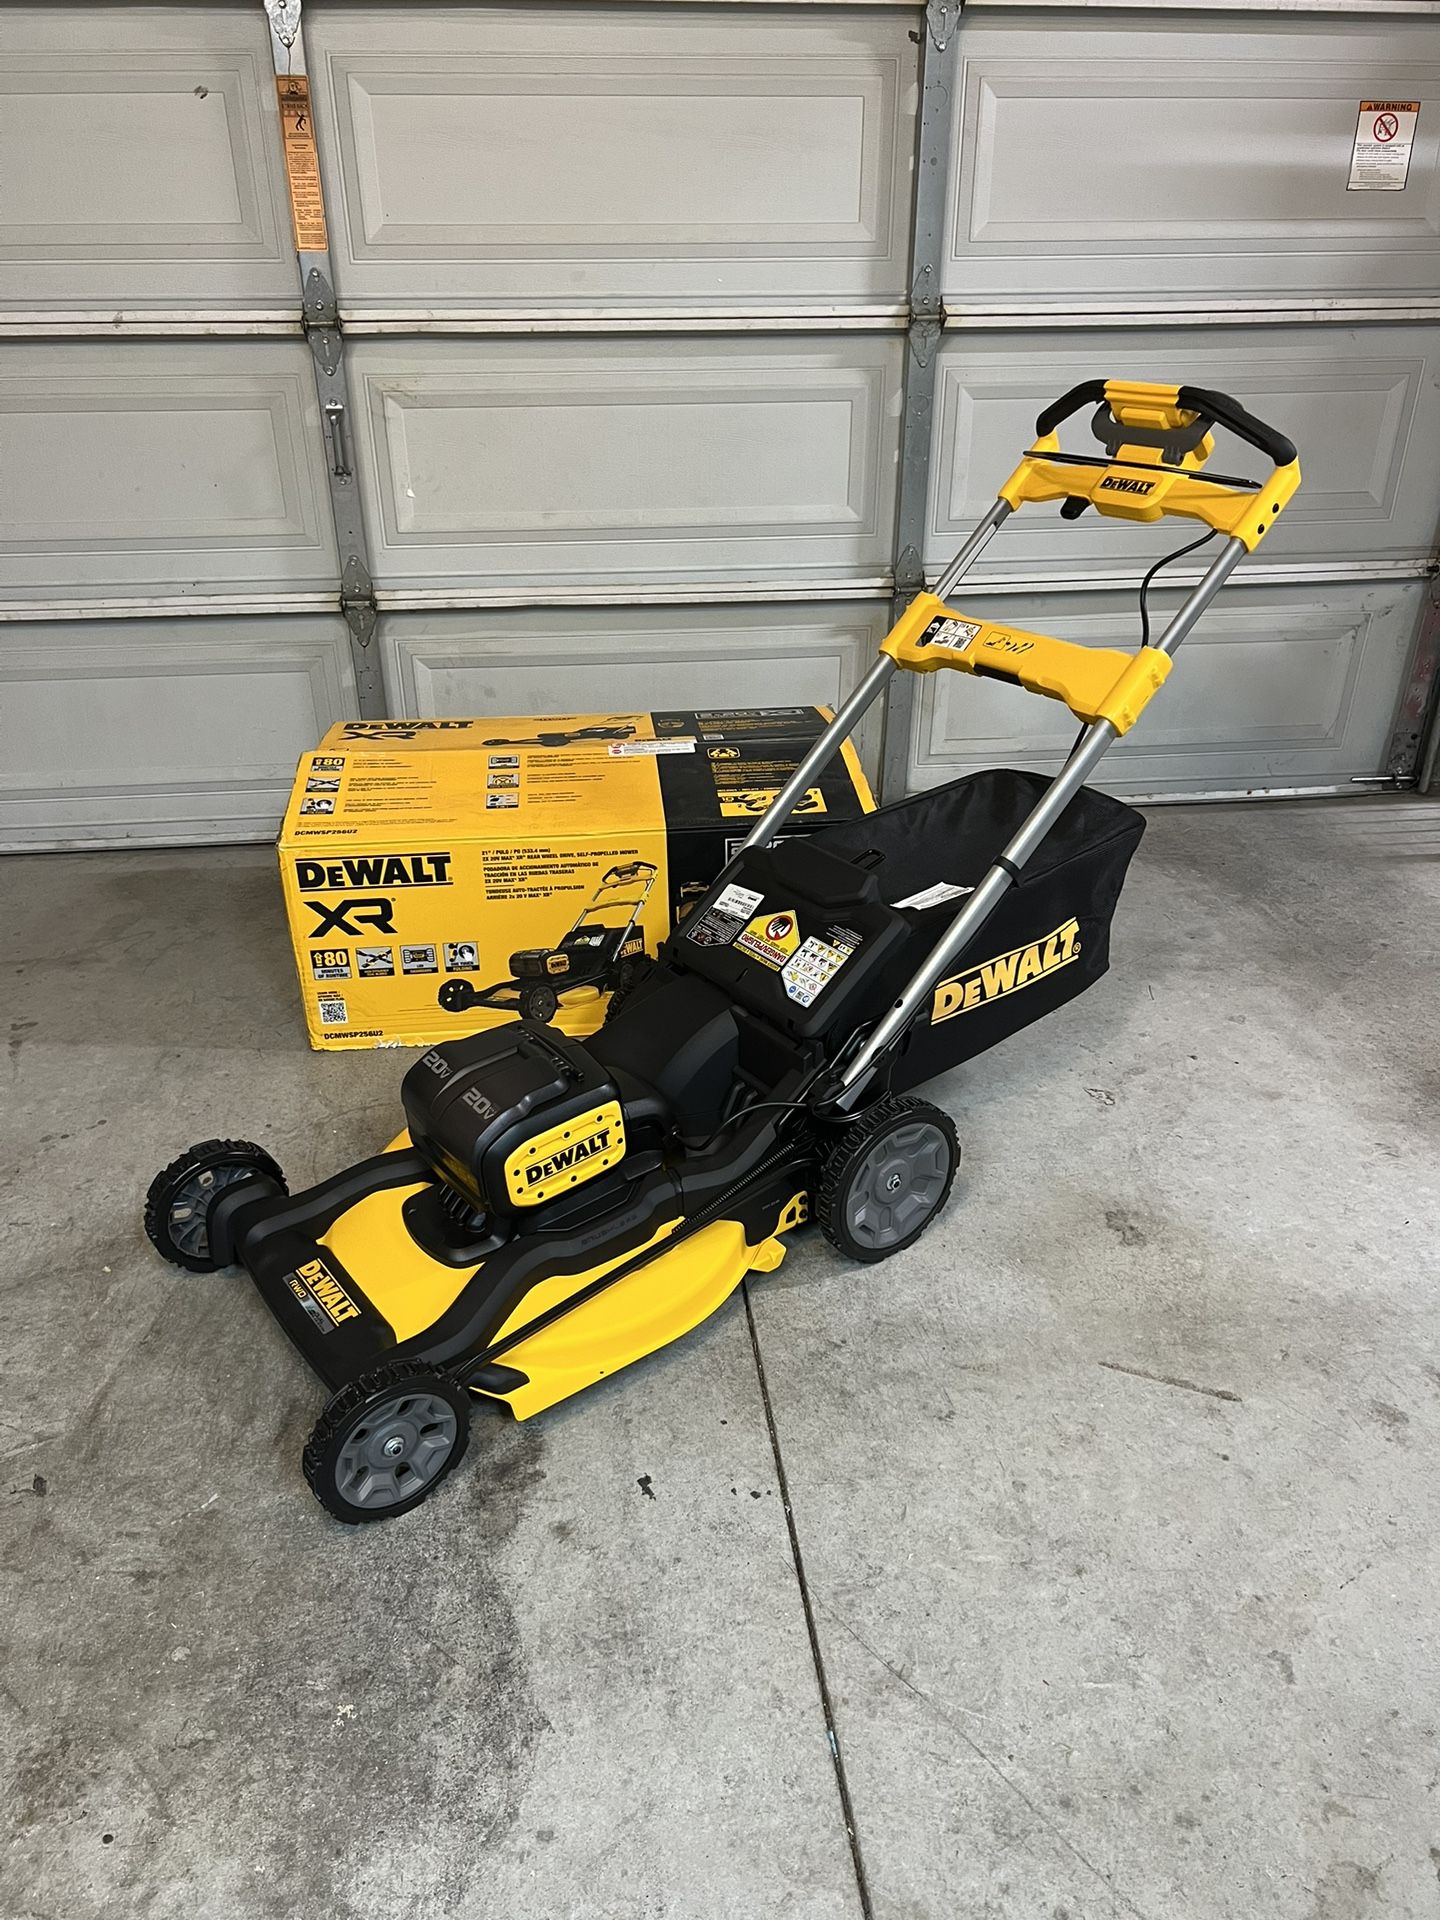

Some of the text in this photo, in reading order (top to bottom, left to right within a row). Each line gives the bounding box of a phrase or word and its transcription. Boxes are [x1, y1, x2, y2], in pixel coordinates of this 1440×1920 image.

[1101, 477, 1155, 495] DEWALT
[343, 721, 474, 730] DEWALT
[338, 731, 417, 740] XR
[324, 758, 344, 766] 80
[296, 856, 452, 888] DEWALT
[302, 897, 398, 938] XR
[324, 951, 347, 966] 80
[324, 1030, 384, 1040] DCMWSP256U2
[422, 1050, 453, 1079] 20V
[462, 1087, 497, 1120] 20V
[525, 1130, 611, 1184] DEWALT
[289, 1279, 307, 1298] RWD
[298, 1259, 359, 1323] DEWALT
